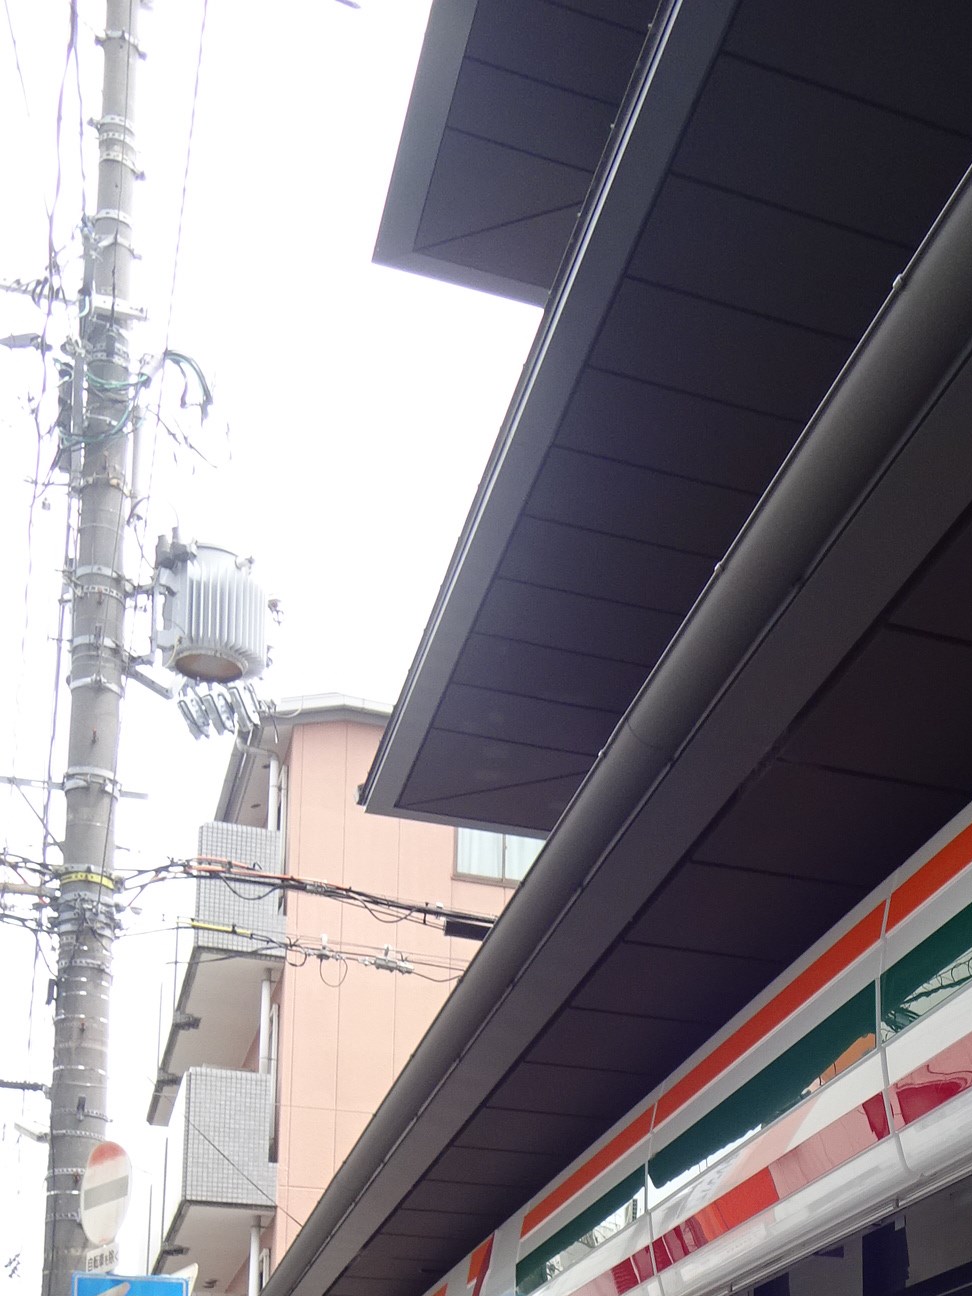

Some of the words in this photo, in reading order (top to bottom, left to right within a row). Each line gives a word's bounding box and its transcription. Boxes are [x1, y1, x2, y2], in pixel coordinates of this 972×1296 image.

[87, 1249, 119, 1272] 自転車を除く
